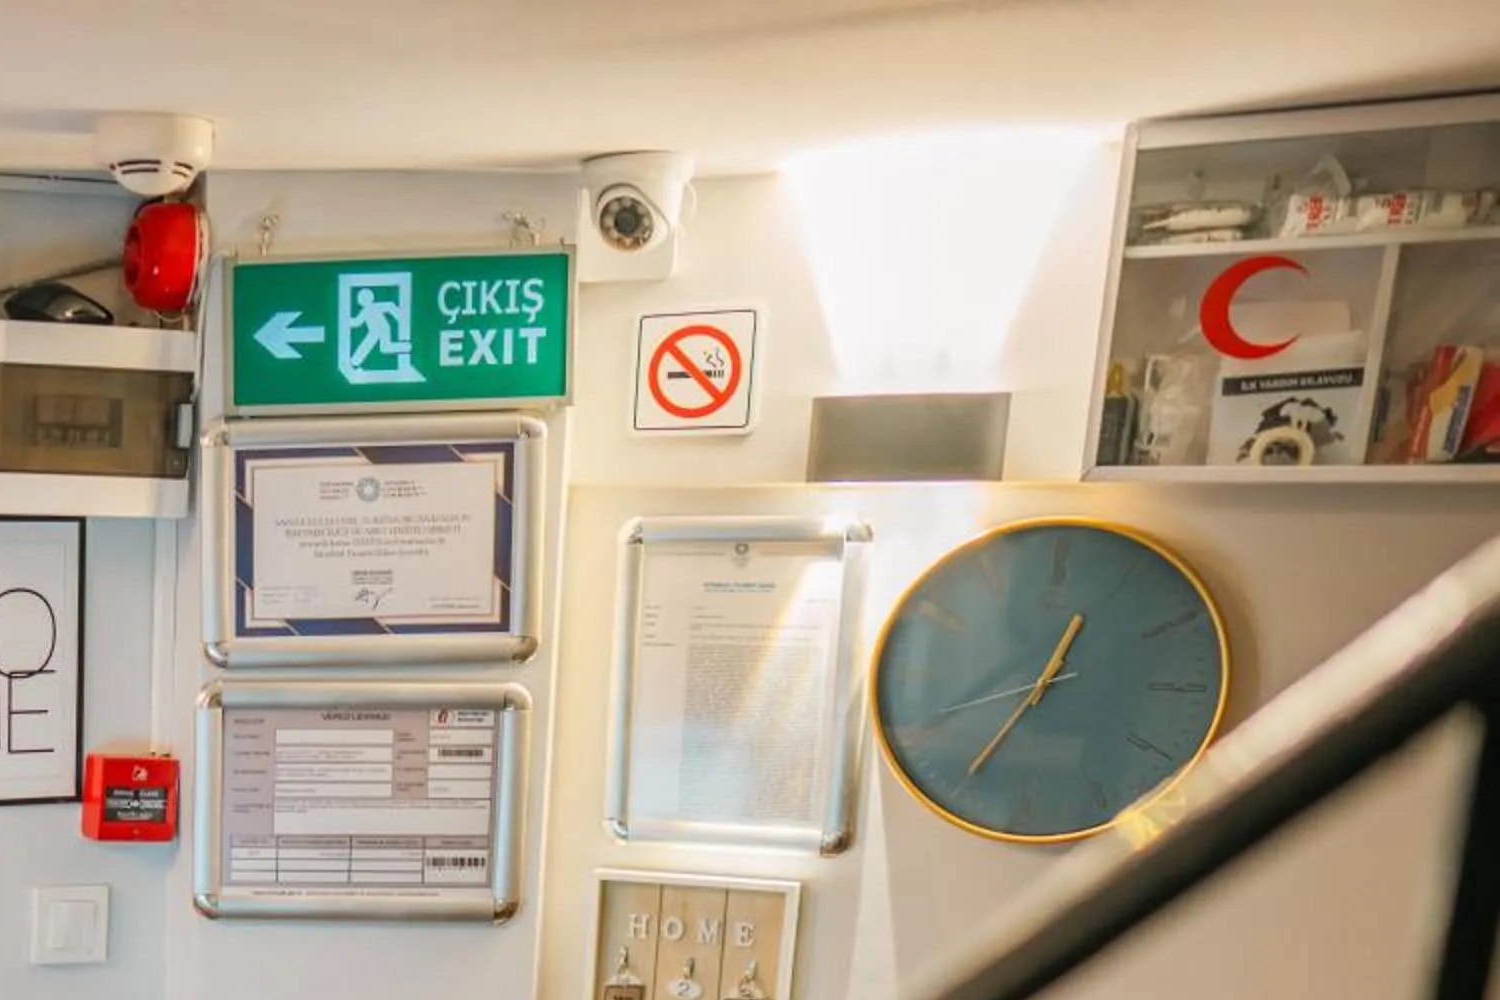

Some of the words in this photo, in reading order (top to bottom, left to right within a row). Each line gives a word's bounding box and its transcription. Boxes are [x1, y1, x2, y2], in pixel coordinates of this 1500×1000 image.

[437, 278, 545, 323] ÇIKIŞ
[438, 327, 547, 367] EXIT
[627, 914, 756, 947] HOME
